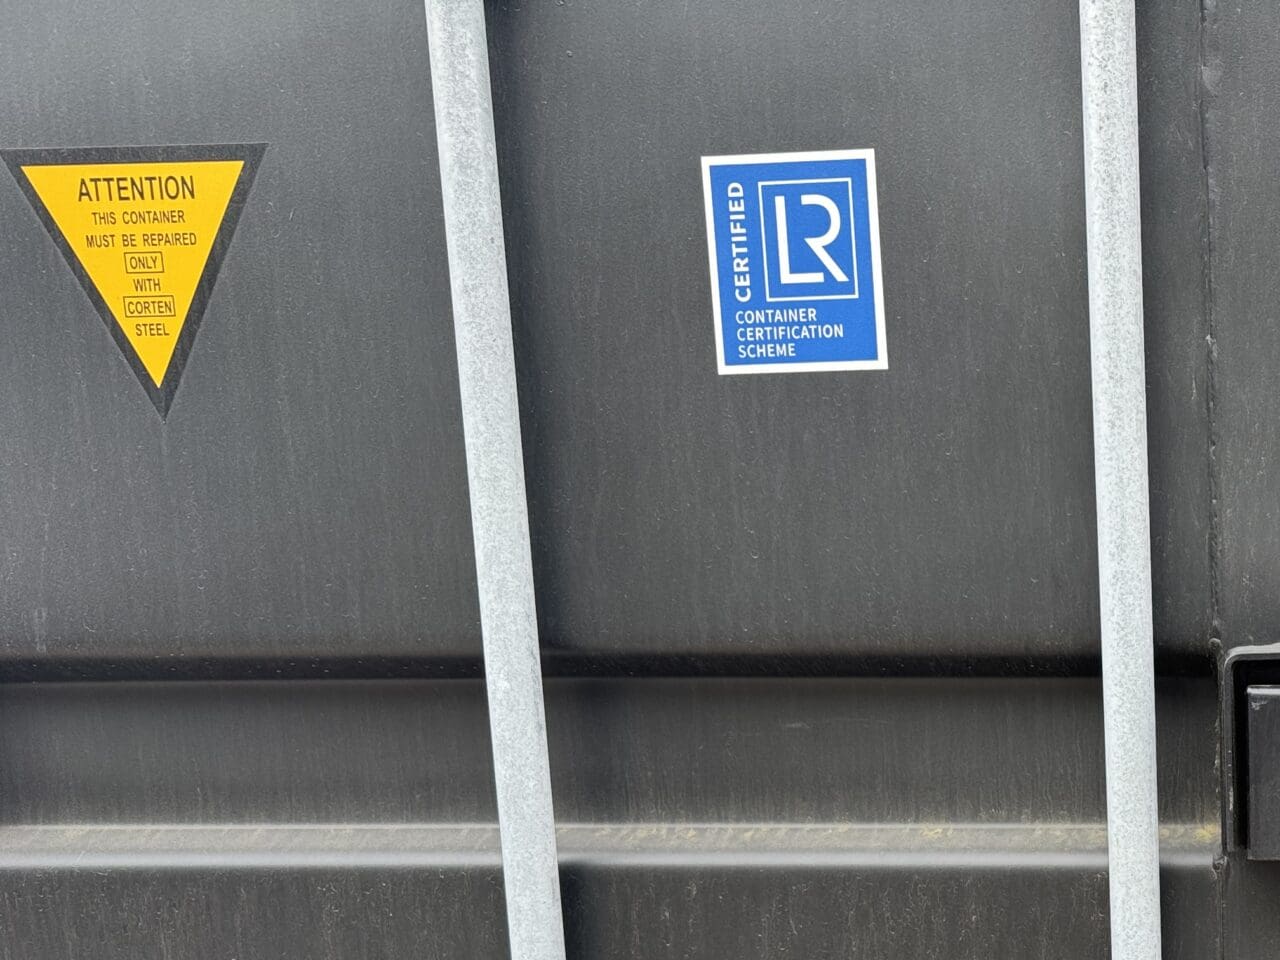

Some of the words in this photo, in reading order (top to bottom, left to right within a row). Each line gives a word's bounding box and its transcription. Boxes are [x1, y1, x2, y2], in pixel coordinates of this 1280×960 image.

[78, 175, 195, 202] ATTENTION
[92, 212, 117, 226] THIS
[122, 210, 186, 225] CONTAINER
[86, 234, 116, 248] MUST
[122, 233, 137, 248] BE
[142, 232, 197, 247] REPAIRED
[727, 182, 751, 303] CERTIFIED
[774, 194, 850, 285] LR
[129, 256, 158, 270] ONLY
[133, 278, 161, 292] WITH
[127, 301, 173, 315] CORTEN
[735, 308, 817, 324] CONTAINER
[135, 323, 170, 337] STEEL
[736, 324, 844, 341] CERTIFICATION
[738, 343, 797, 358] SCHEME
